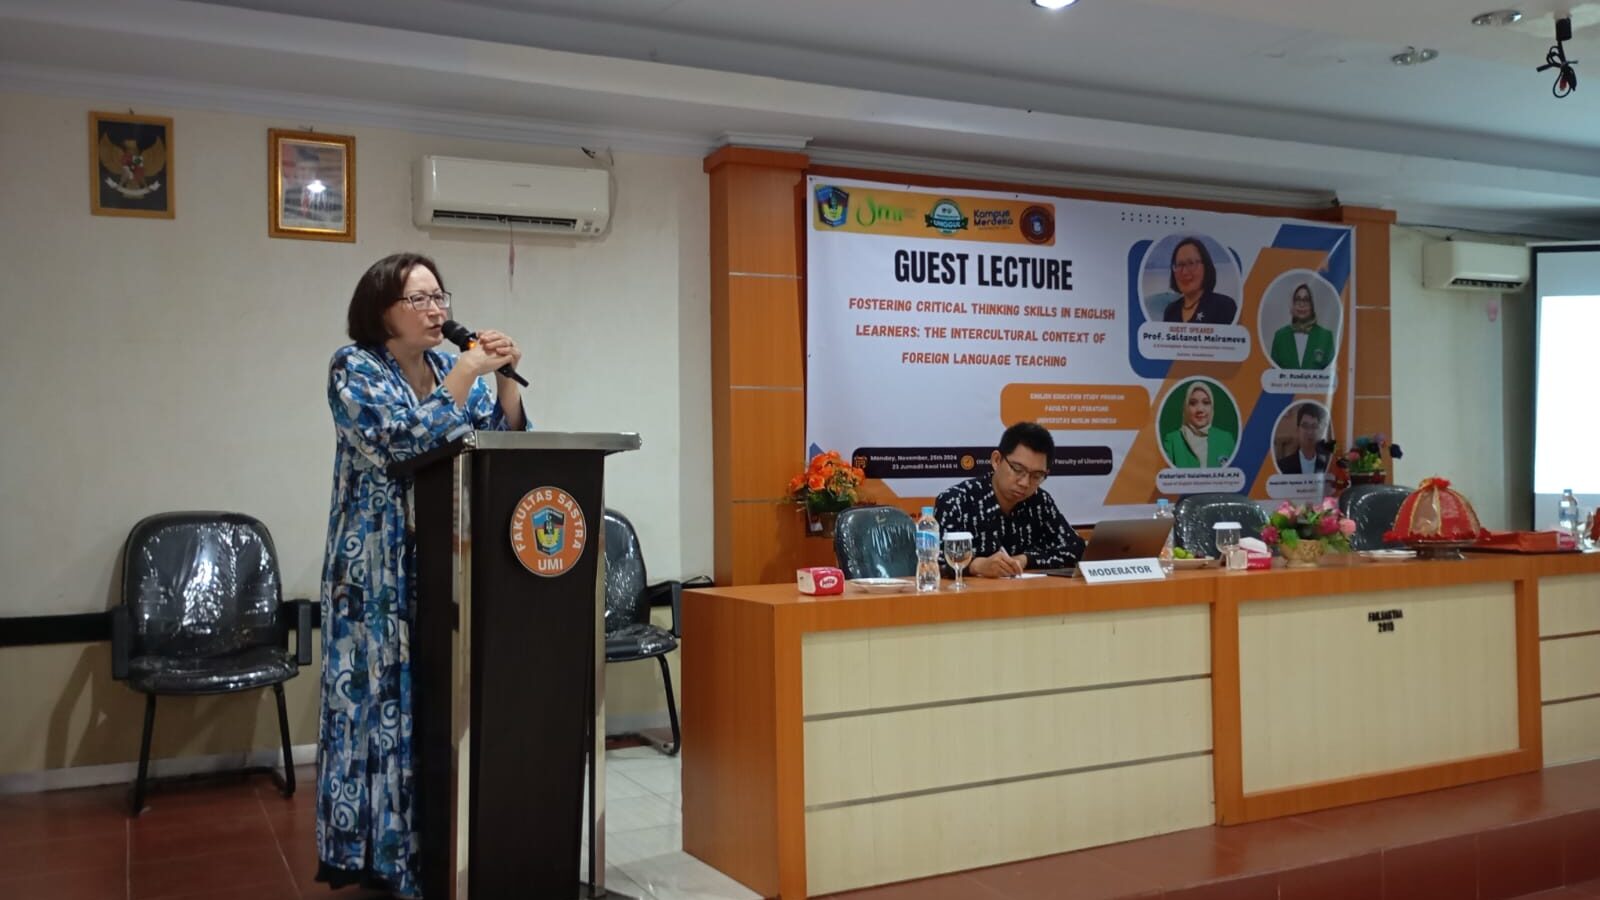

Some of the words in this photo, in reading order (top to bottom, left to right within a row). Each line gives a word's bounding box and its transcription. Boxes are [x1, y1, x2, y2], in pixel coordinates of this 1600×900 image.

[894, 249, 969, 285] GUEST
[978, 254, 1073, 291] LECTURE
[849, 298, 912, 312] FOSTERING
[916, 301, 967, 314] CRITICAL
[971, 303, 1020, 316] THINKING
[1024, 305, 1057, 317] SKILLS
[1061, 307, 1071, 318] IN
[1074, 308, 1116, 320] ENGLISH
[856, 324, 920, 338] LEARNERS:
[924, 327, 947, 339] THE
[951, 328, 1038, 341] INTERCULTURAL
[1042, 331, 1089, 343] CONTEXT
[1093, 333, 1106, 344] OF
[1143, 332, 1165, 340] Prof.
[1166, 333, 1201, 342] Saltanat
[902, 352, 949, 364] FOREIGN
[953, 353, 1011, 366] LANGUAGE
[1015, 355, 1067, 367] TEACHING
[1054, 458, 1076, 466] Faculty
[513, 489, 553, 552] FAKULTAS
[557, 493, 583, 549] SASTRA
[538, 558, 563, 571] UMI
[1088, 565, 1152, 577] MODERATOR
